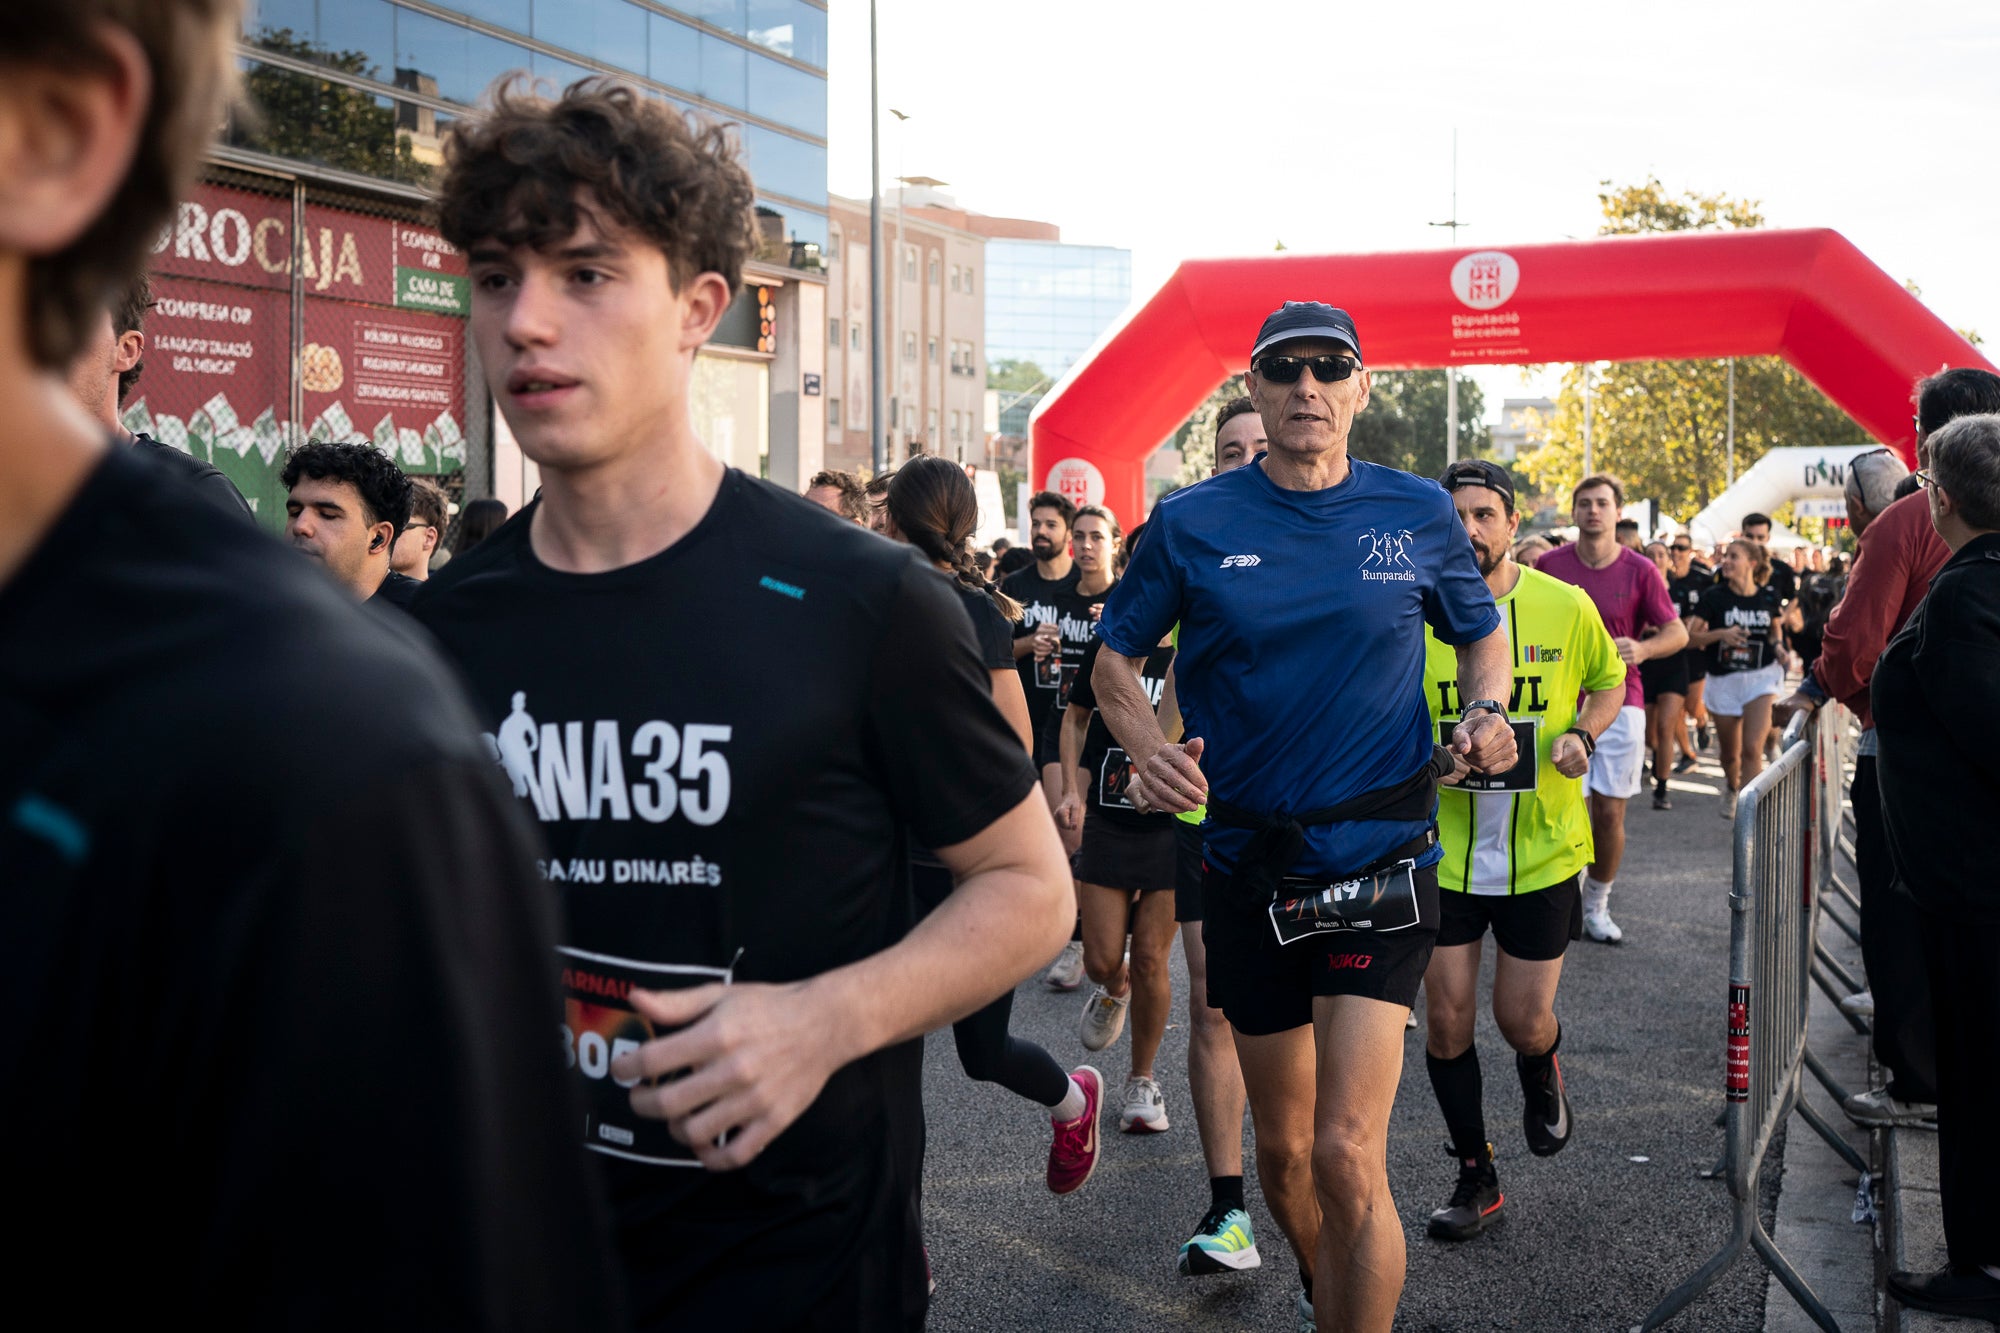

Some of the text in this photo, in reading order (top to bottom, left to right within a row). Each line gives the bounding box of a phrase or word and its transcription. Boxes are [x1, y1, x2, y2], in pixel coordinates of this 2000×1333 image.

[1452, 325, 1520, 339] Barcelona
[1383, 532, 1392, 566] GRUP
[1361, 569, 1416, 584] Runparadís
[613, 854, 722, 887] DINARÈS
